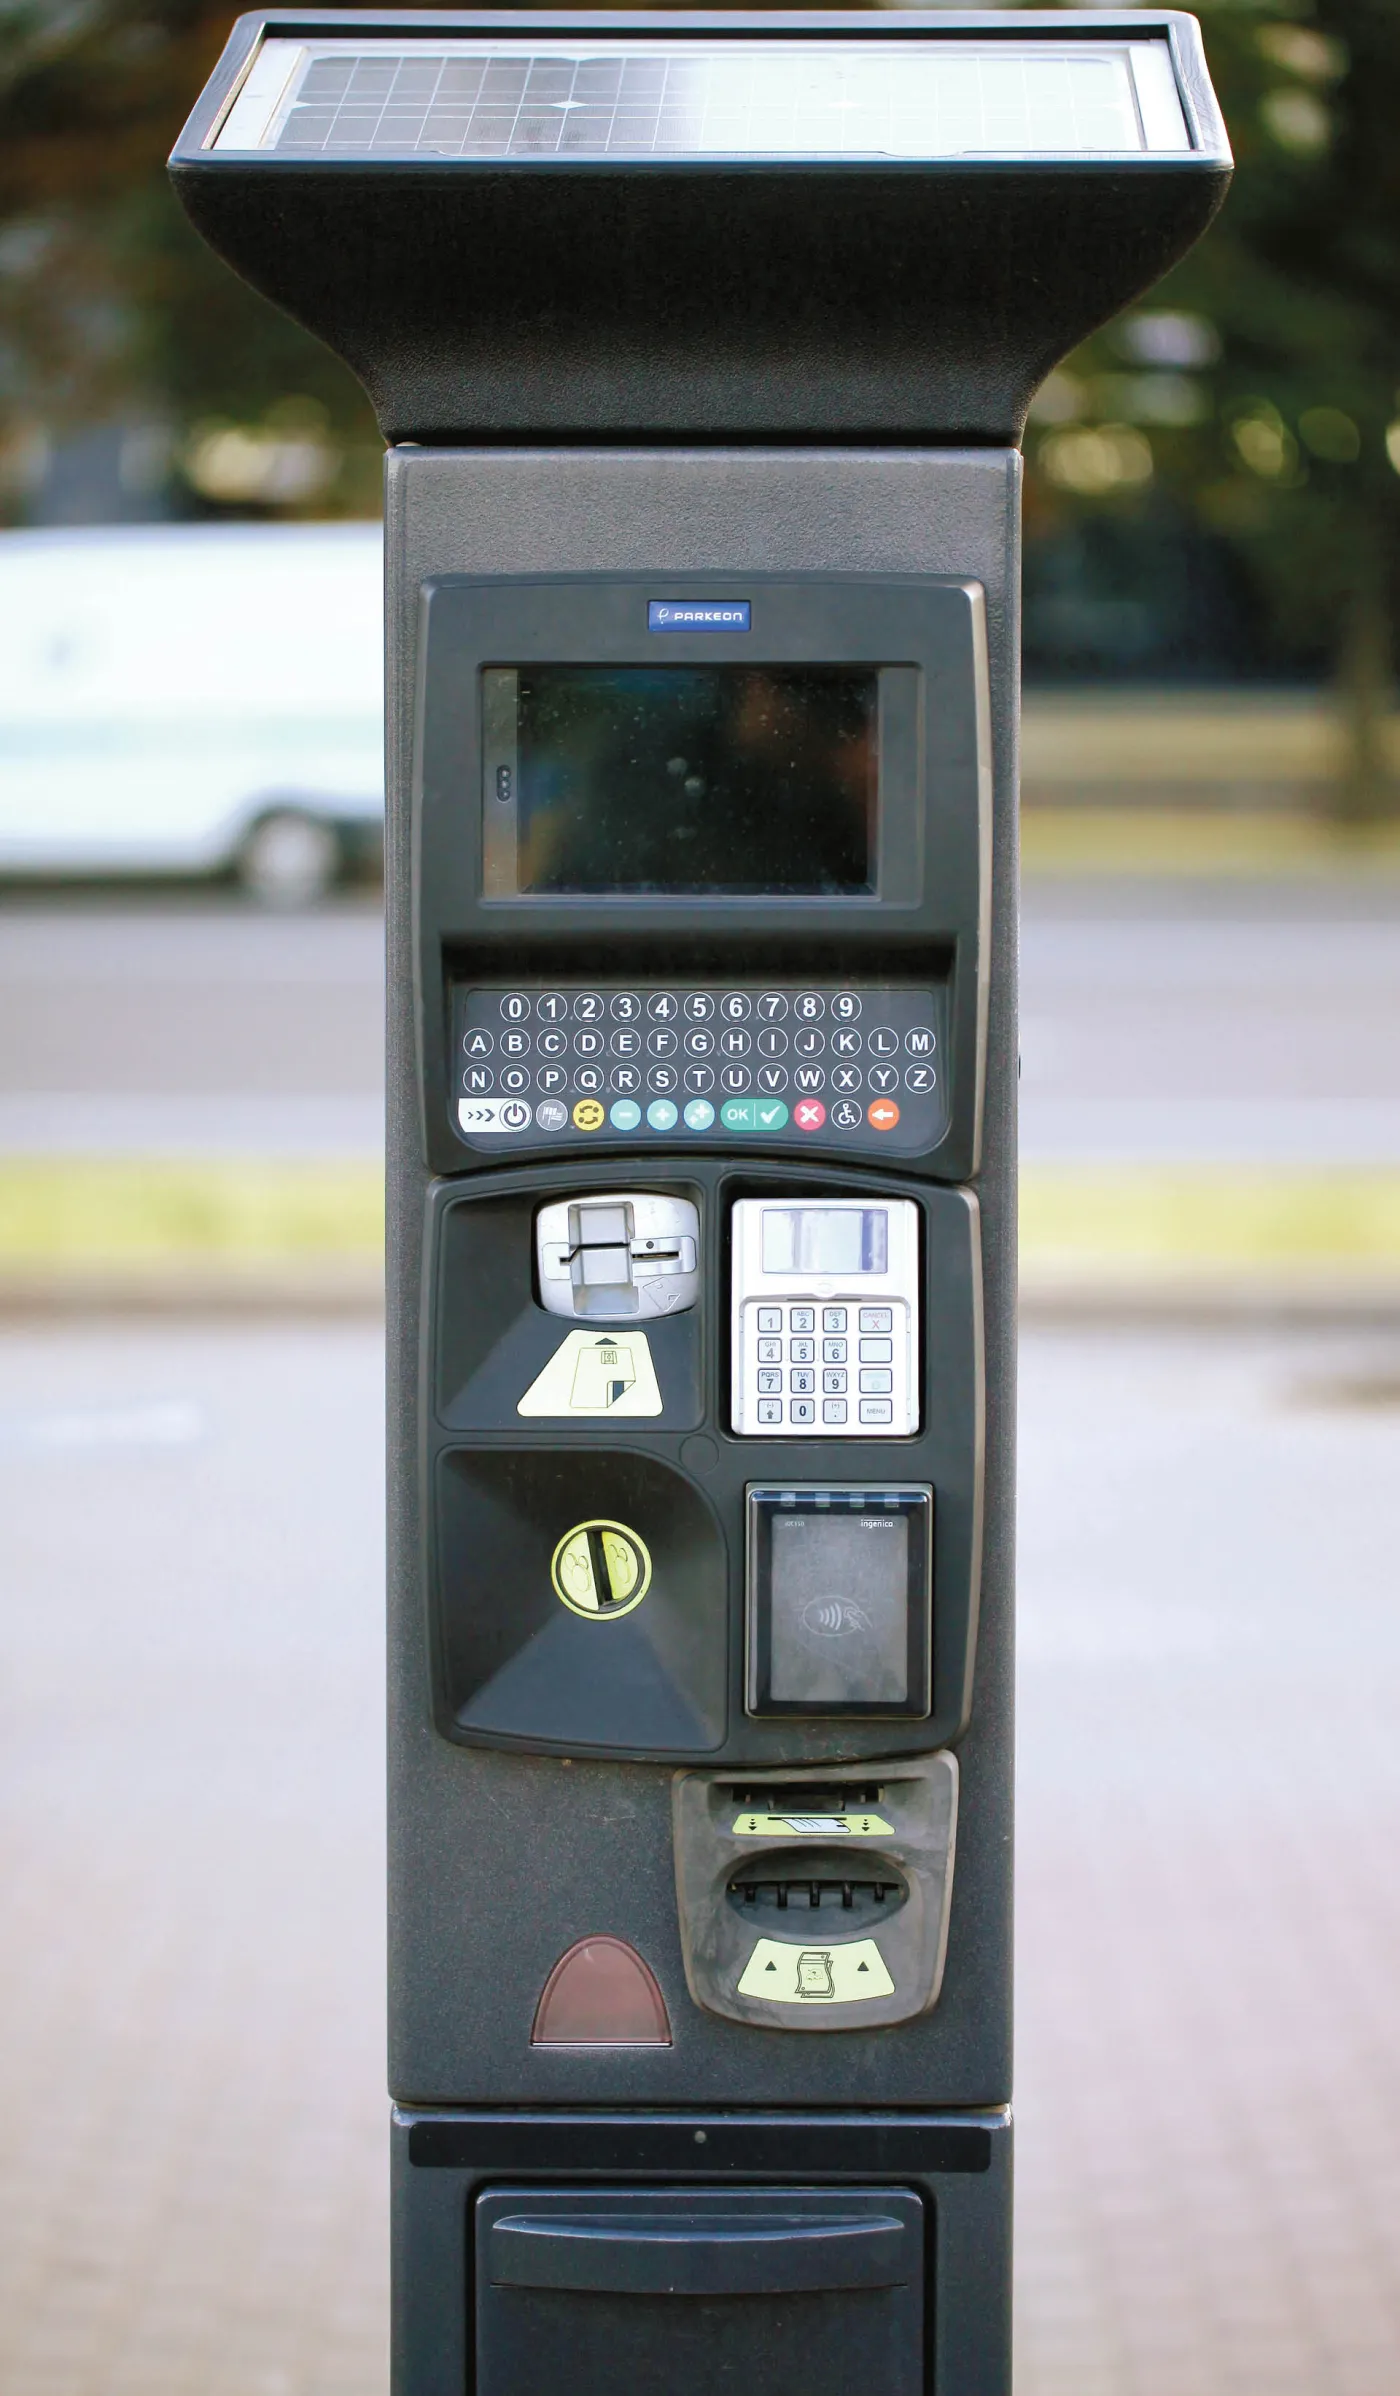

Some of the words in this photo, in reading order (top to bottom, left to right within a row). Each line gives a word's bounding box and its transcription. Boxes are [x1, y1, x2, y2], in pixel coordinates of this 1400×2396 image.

[673, 612, 743, 621] PARKEON
[508, 999, 522, 1018] 0
[581, 998, 596, 1018] 2
[618, 998, 633, 1018] 3
[655, 998, 670, 1018] 4
[692, 998, 707, 1018] 5
[729, 998, 743, 1018] 6
[765, 998, 780, 1018] 7
[802, 998, 817, 1018] 8
[839, 998, 854, 1018] 9
[470, 1035, 487, 1051] A
[508, 1034, 523, 1051] B
[544, 1034, 560, 1051] C
[581, 1034, 597, 1051] D
[619, 1034, 633, 1051] E
[656, 1034, 669, 1051] F
[691, 1034, 708, 1051] G
[729, 1034, 743, 1050] H
[803, 1033, 815, 1050] J
[839, 1033, 855, 1050] K
[877, 1034, 891, 1050] L
[911, 1034, 929, 1050] M
[471, 1071, 486, 1087] N
[506, 1070, 524, 1087] O
[545, 1070, 559, 1087] P
[580, 1070, 598, 1088] Q
[618, 1070, 634, 1087] R
[655, 1070, 670, 1087] S
[692, 1070, 707, 1087] T
[729, 1070, 743, 1087] U
[765, 1070, 781, 1087] V
[799, 1070, 821, 1086] W
[839, 1070, 855, 1086] X
[875, 1070, 891, 1086] Y
[913, 1070, 928, 1086] Z
[727, 1108, 749, 1120] OK
[767, 1317, 773, 1328] 1
[799, 1317, 807, 1328] 2
[832, 1317, 839, 1329] 3
[766, 1347, 774, 1359] 4
[800, 1348, 807, 1359] 5
[832, 1348, 839, 1359] 6
[766, 1378, 774, 1389] 7
[799, 1378, 807, 1390] 8
[832, 1378, 839, 1390] 9
[799, 1405, 807, 1417] 0
[860, 1519, 894, 1528] ingenico
